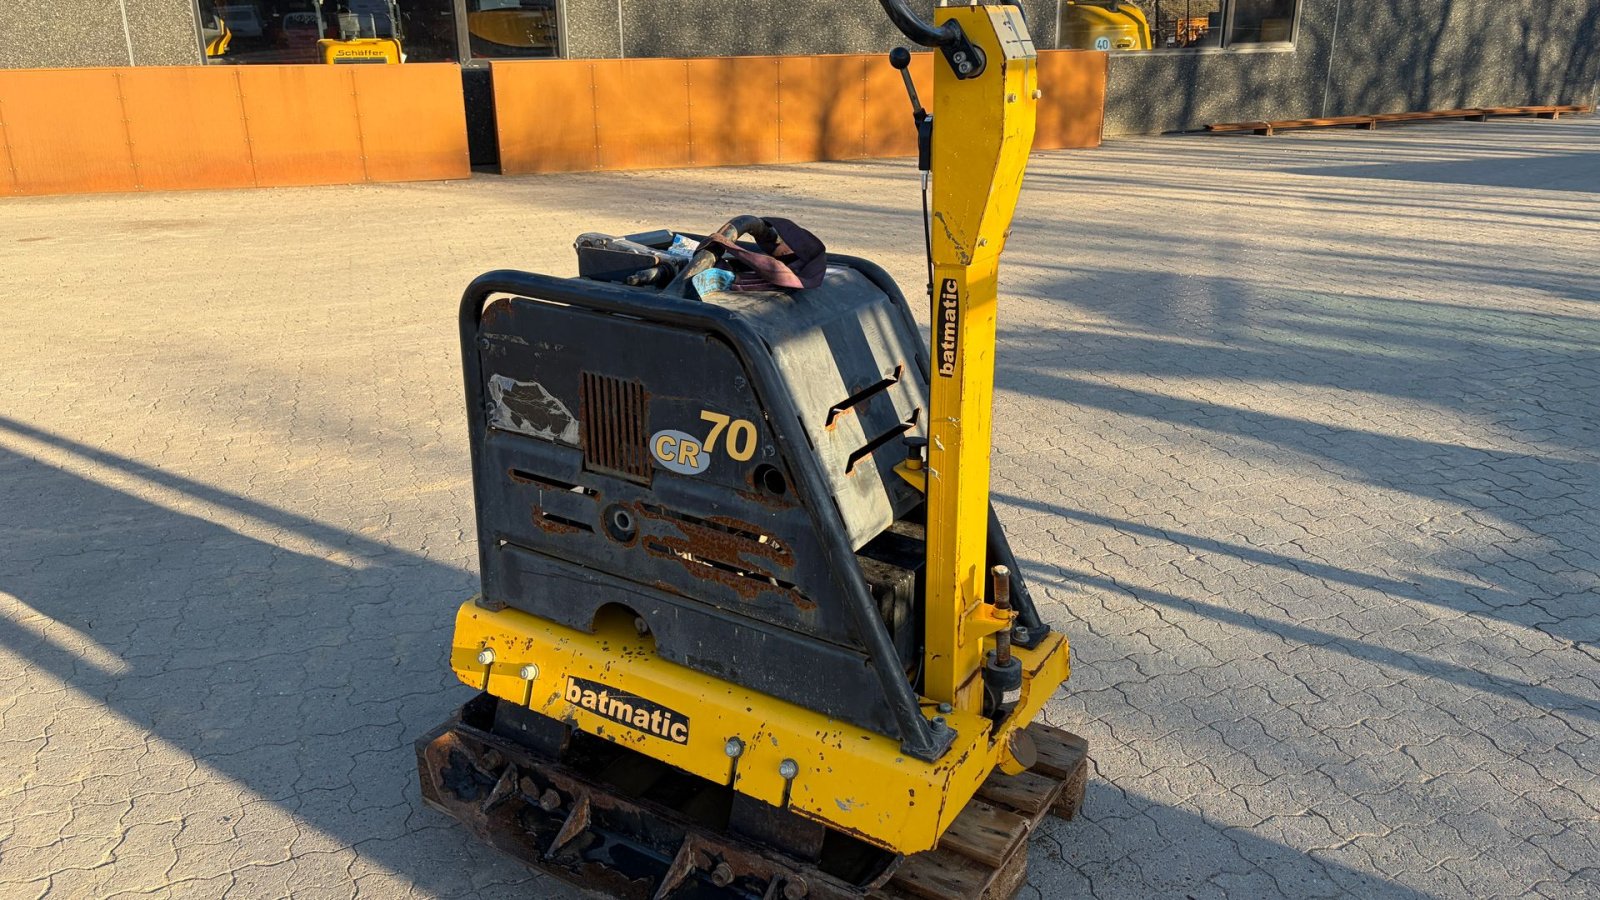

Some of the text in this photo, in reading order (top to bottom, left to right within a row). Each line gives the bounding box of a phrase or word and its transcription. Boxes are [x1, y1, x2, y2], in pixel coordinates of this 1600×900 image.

[1097, 39, 1109, 50] 40
[939, 279, 958, 375] batmatic
[655, 409, 758, 469] CR 70
[565, 677, 688, 743] batmatic
